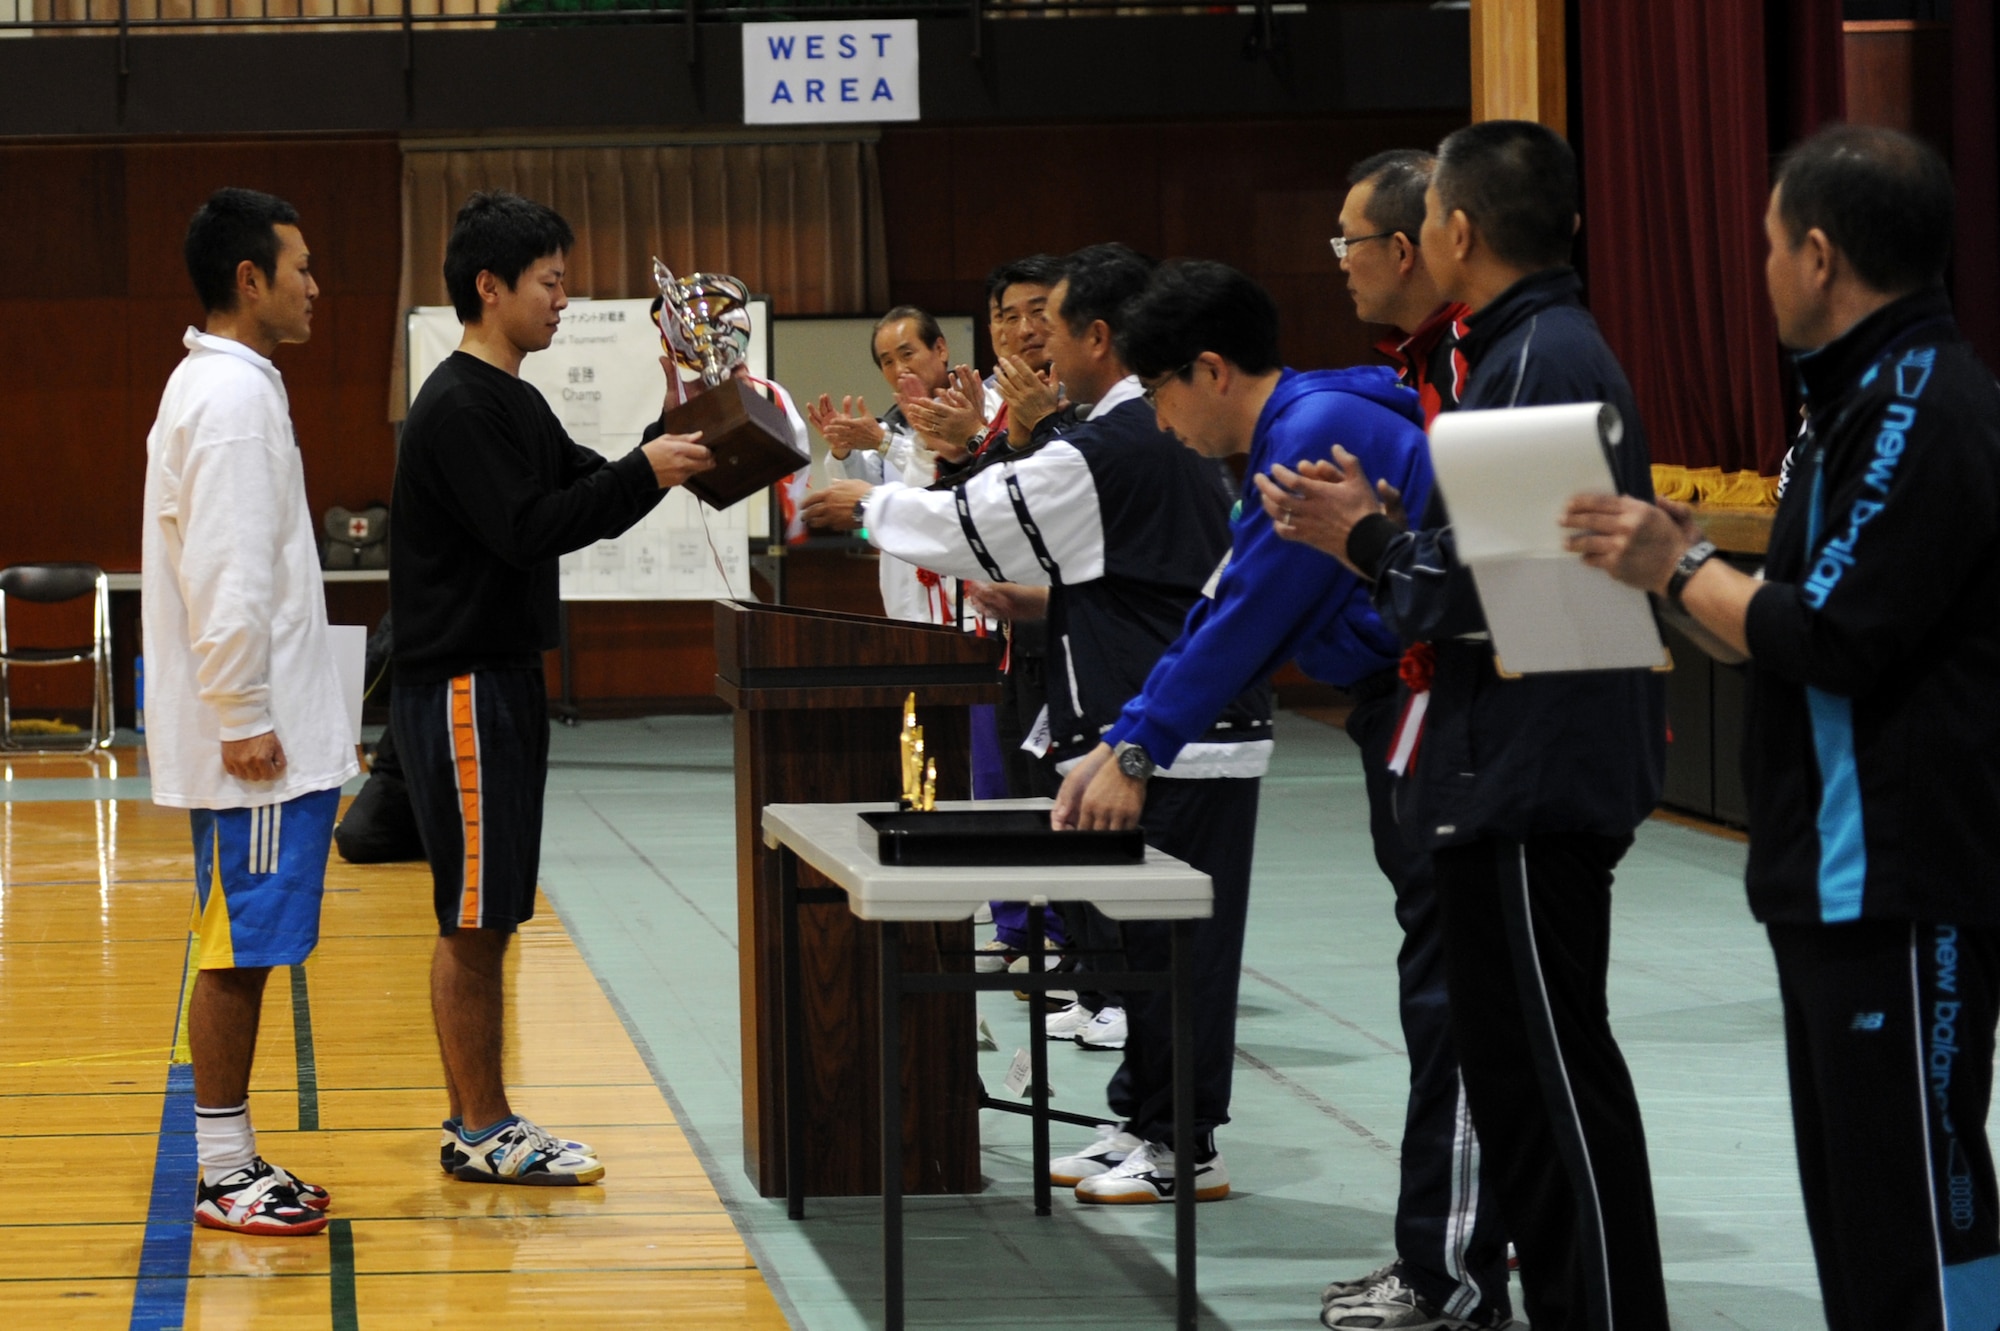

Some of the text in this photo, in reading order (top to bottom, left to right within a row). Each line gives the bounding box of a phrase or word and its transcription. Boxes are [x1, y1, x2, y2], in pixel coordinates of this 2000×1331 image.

[768, 34, 892, 60] WEST
[771, 78, 893, 104] AREA
[562, 387, 602, 402] Champ
[1863, 404, 1918, 494] new
[1935, 924, 1958, 993] new
